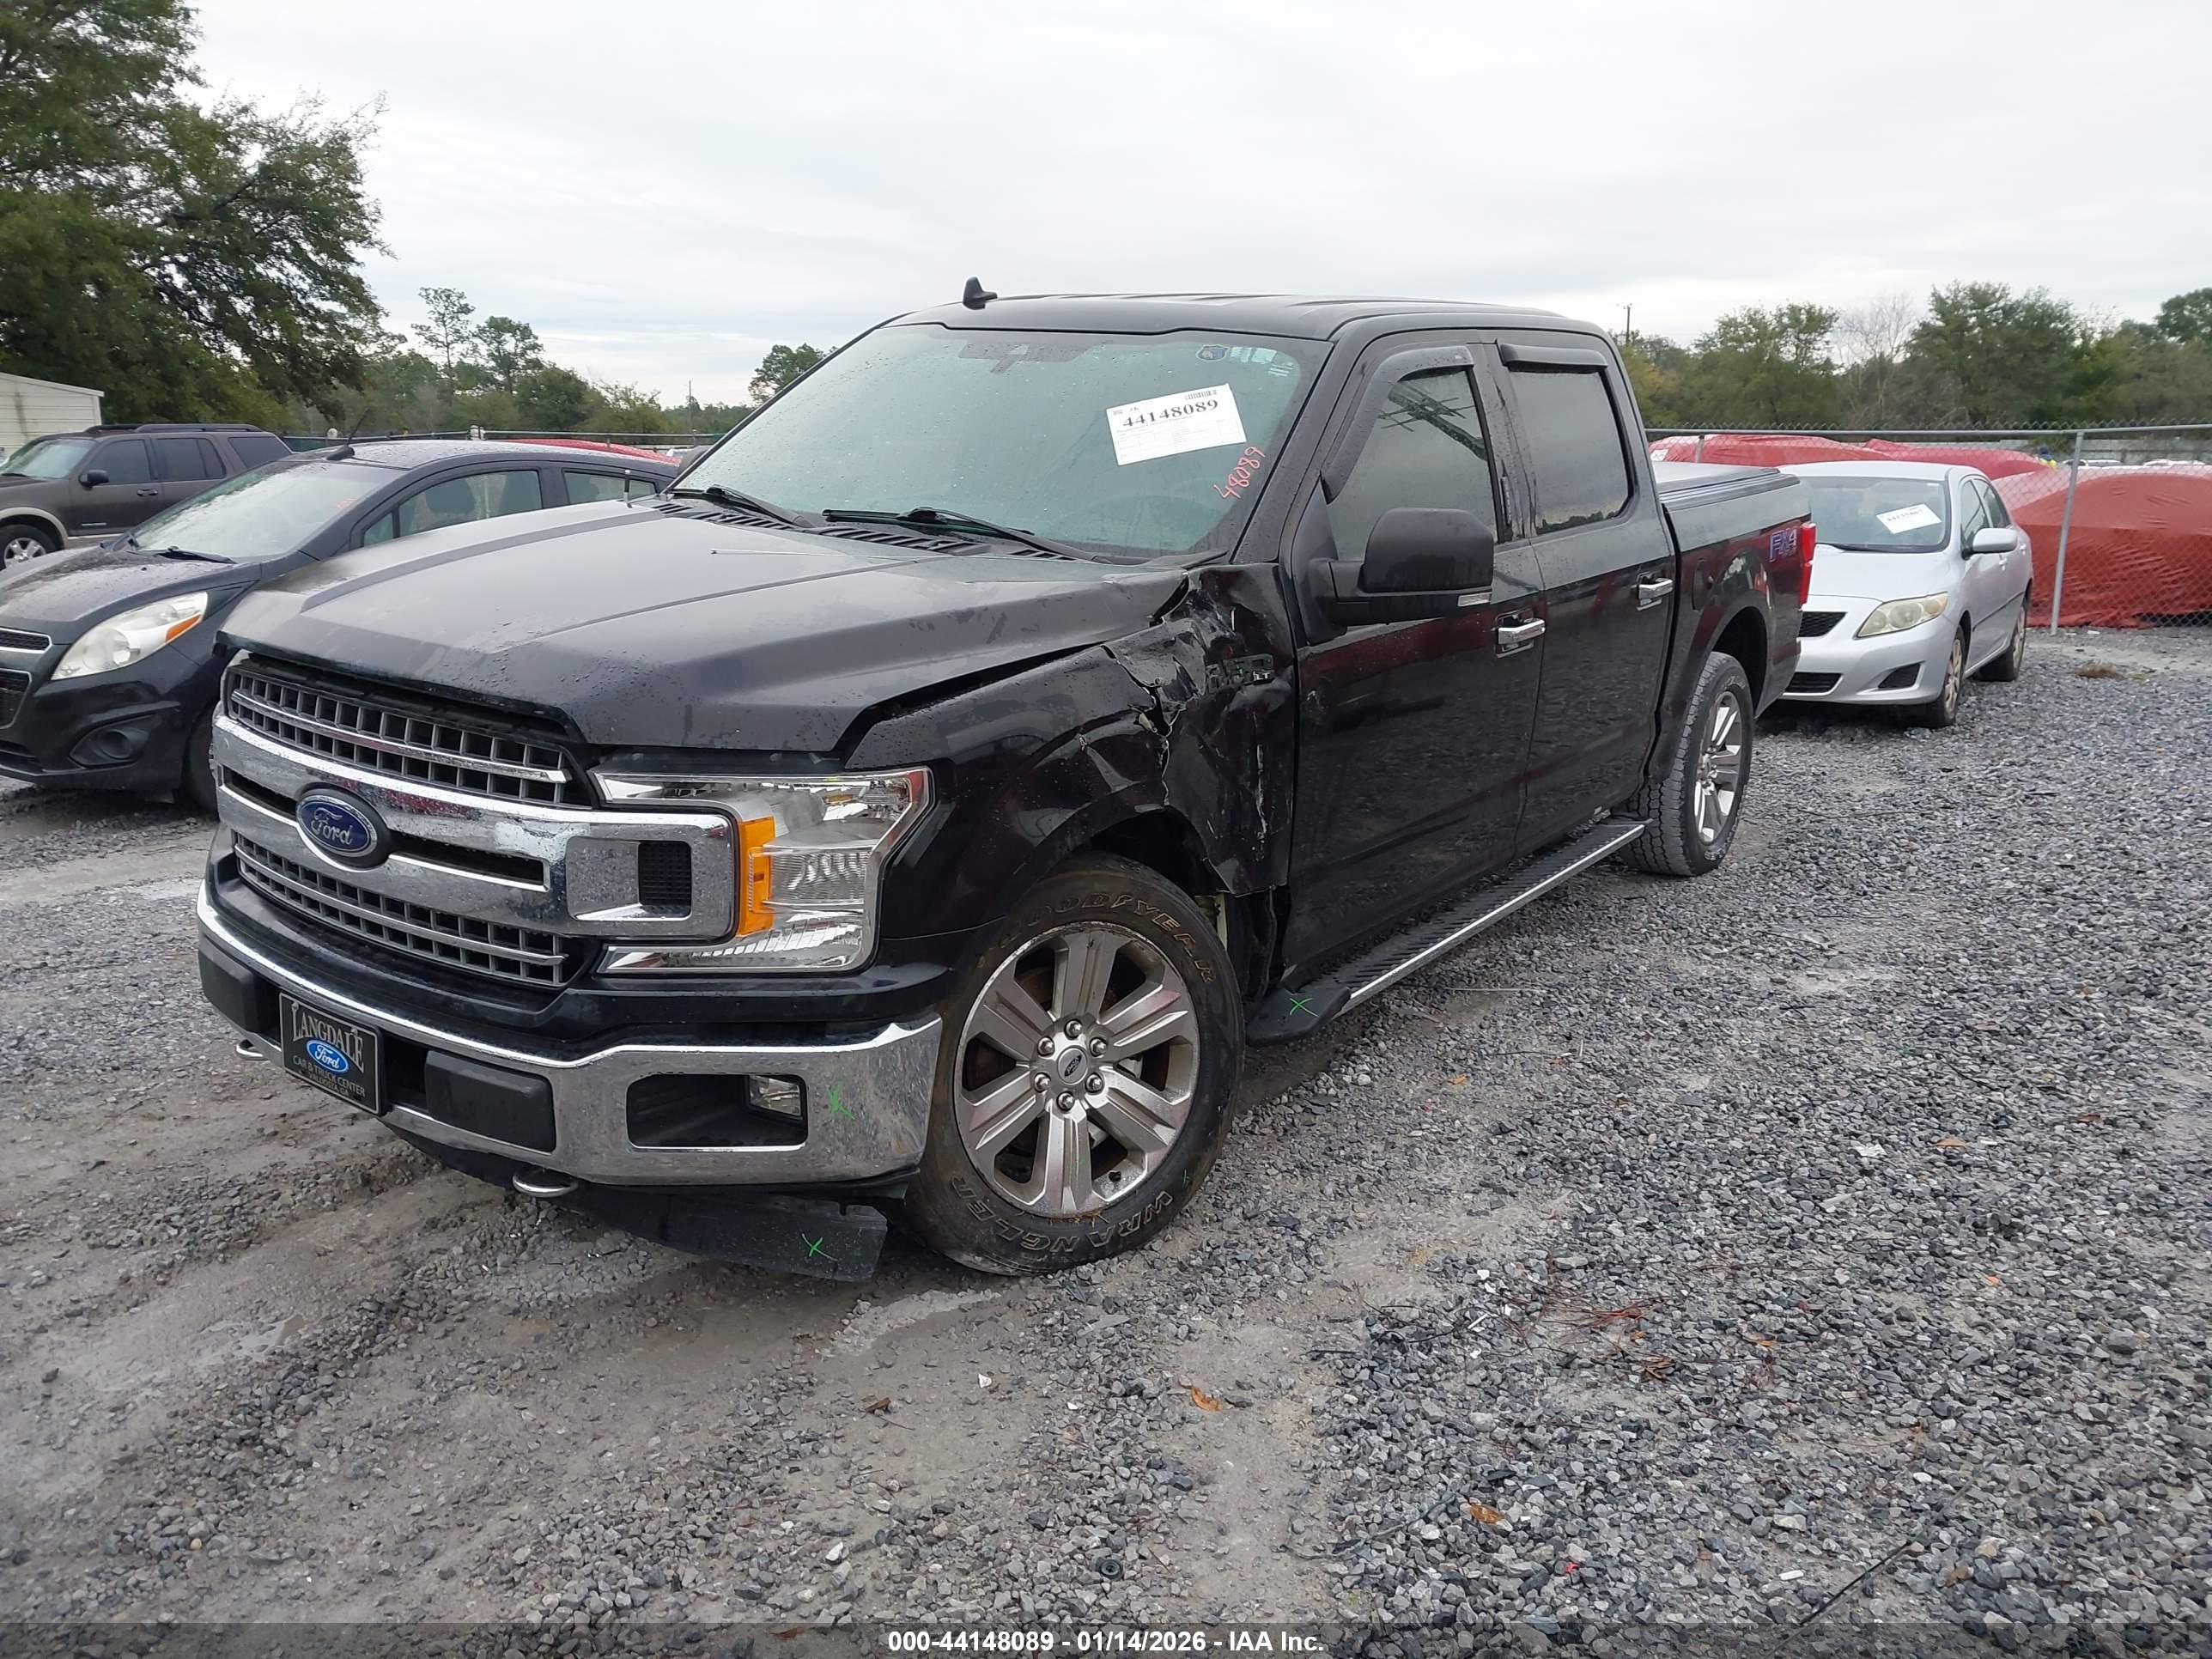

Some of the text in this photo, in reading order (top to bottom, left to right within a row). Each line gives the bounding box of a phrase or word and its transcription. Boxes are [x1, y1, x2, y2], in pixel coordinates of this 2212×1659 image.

[1122, 399, 1218, 428] 44148089
[1213, 447, 1266, 499] 48089
[1770, 527, 1797, 562] FX4
[311, 807, 353, 845] Ford
[292, 1001, 364, 1073] LANGDALE
[314, 1044, 340, 1069] Ford
[337, 1077, 365, 1097] CENTER
[951, 1176, 1173, 1253] WRANGLER
